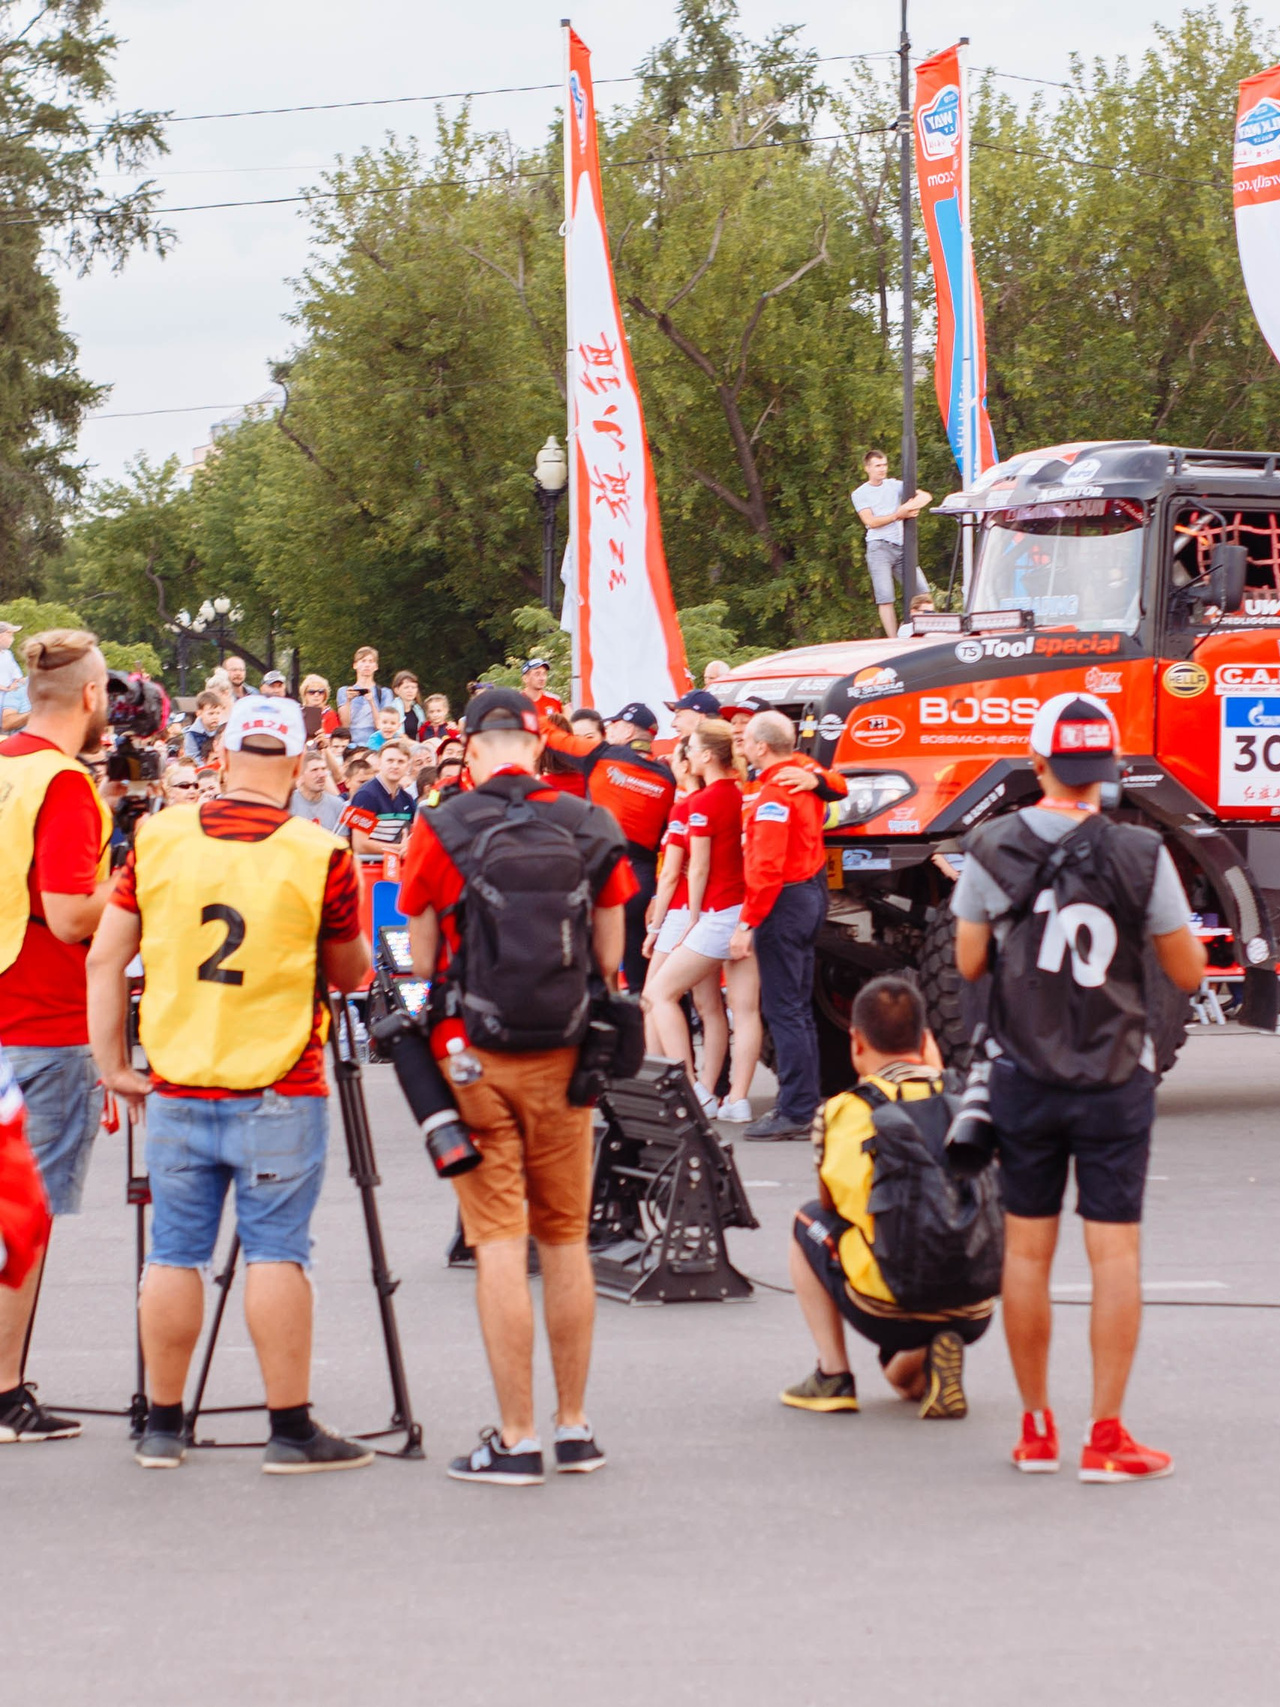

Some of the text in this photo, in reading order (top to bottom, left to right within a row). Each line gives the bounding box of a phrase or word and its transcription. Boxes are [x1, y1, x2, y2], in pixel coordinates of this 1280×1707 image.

[981, 634, 1121, 658] Tool special
[919, 697, 1040, 725] BOSS
[197, 903, 246, 986] 2
[1032, 888, 1118, 988] 10
